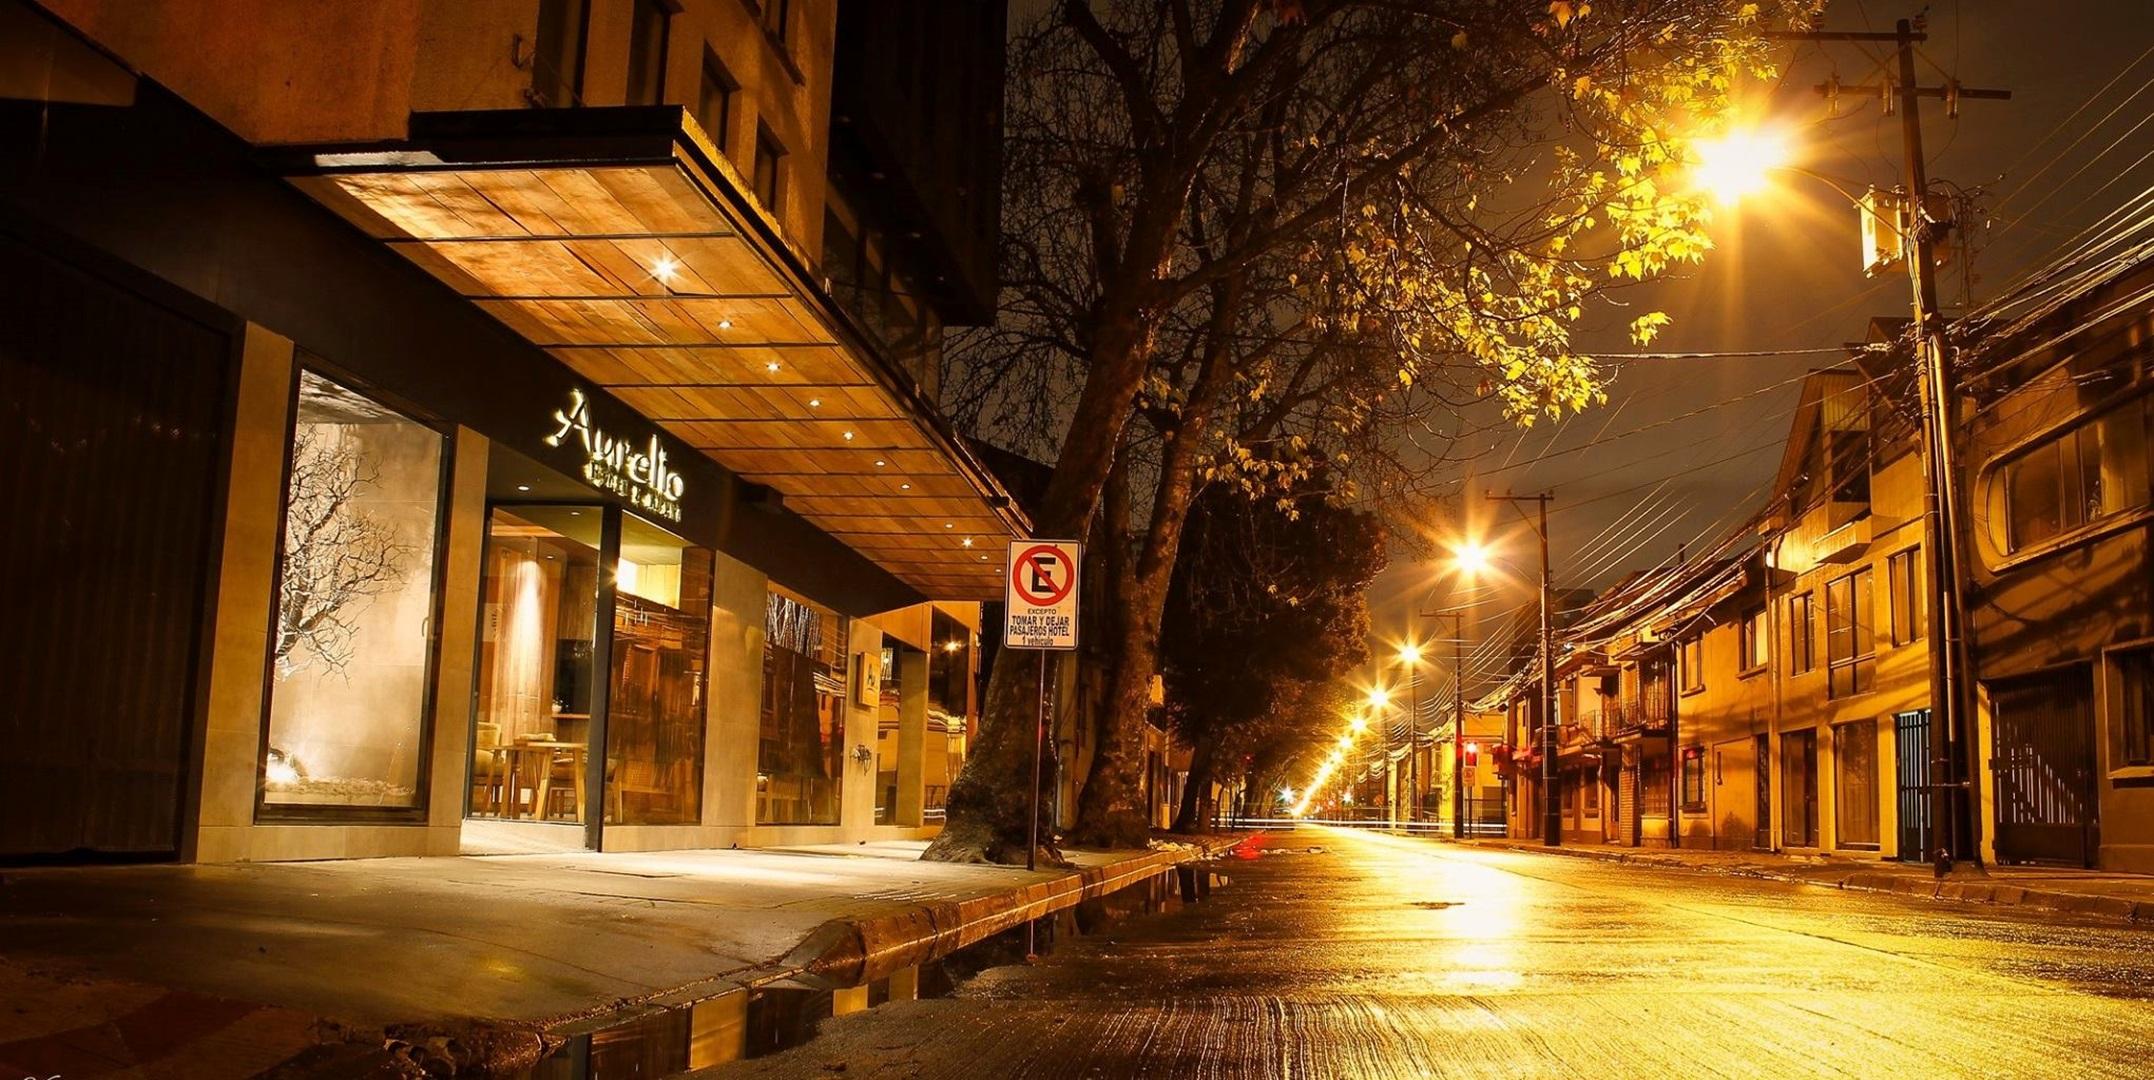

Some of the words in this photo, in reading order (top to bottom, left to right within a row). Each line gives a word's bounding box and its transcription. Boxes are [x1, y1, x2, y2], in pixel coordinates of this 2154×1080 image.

[543, 387, 684, 501] Aurelio
[1012, 615, 1037, 625] TOMAR
[1039, 616, 1044, 626] Y
[1046, 616, 1069, 626] DEJAR
[1009, 625, 1047, 636] PASAJEROS
[1048, 626, 1069, 637] HOTEL
